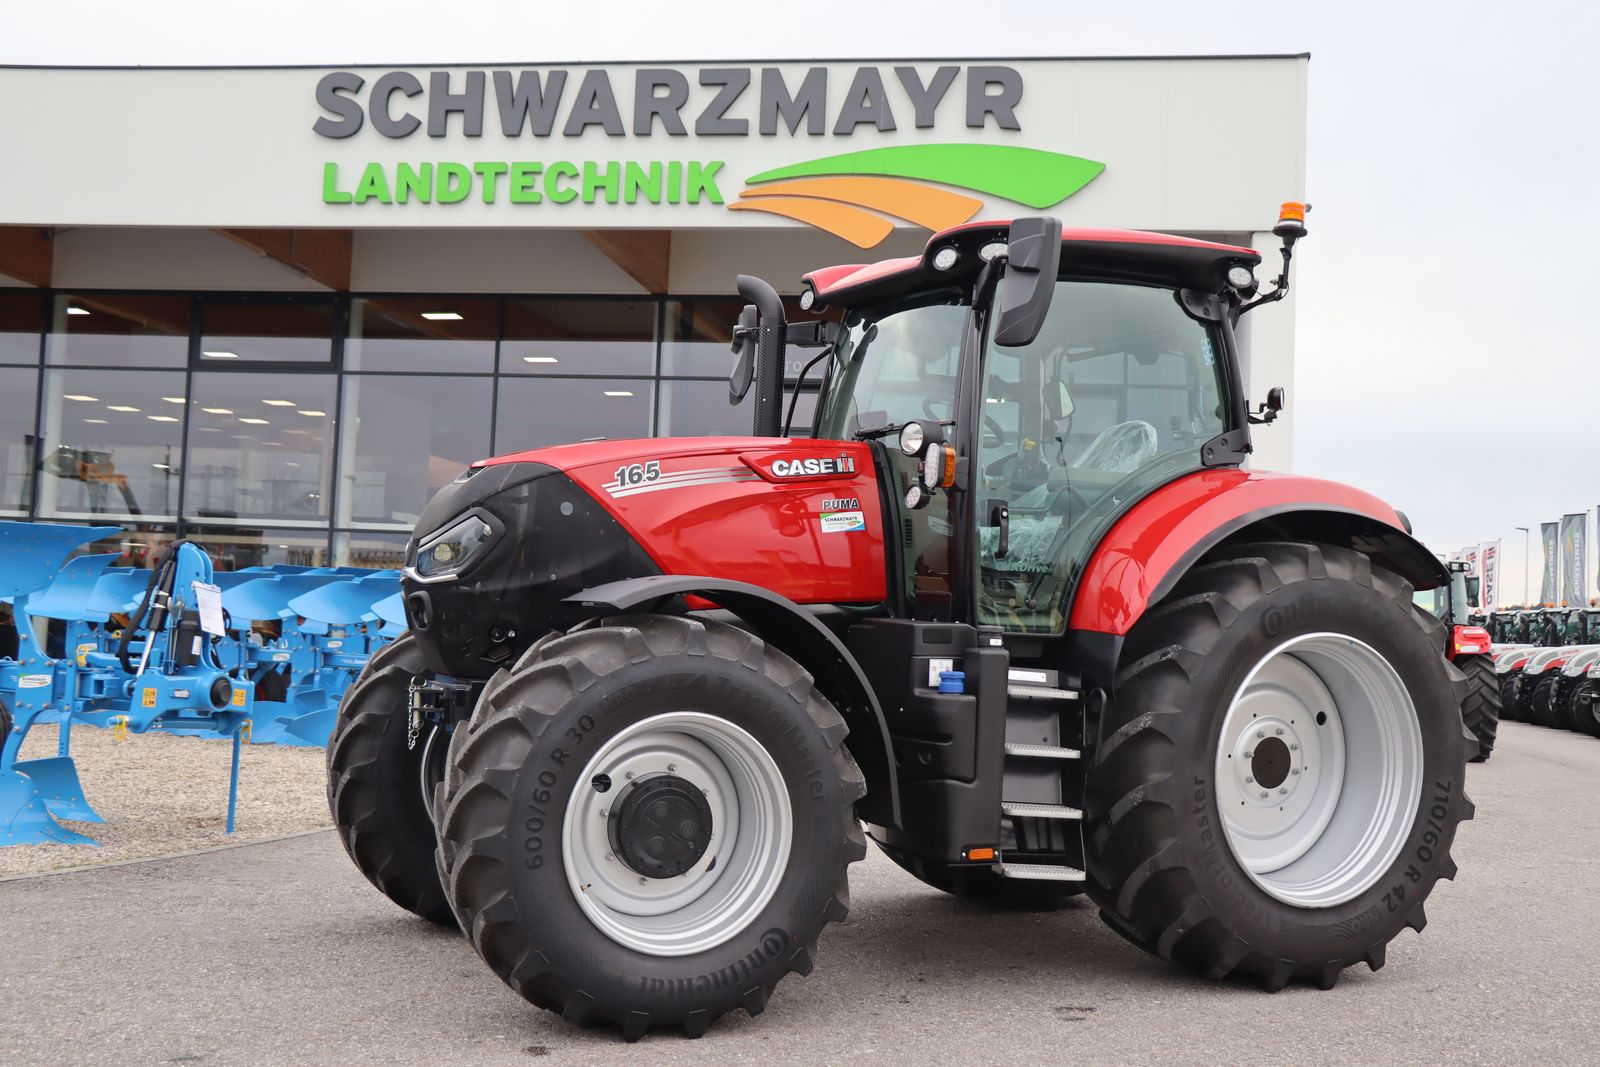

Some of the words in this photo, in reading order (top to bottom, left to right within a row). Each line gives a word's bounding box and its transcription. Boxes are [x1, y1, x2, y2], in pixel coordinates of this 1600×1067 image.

[312, 65, 1024, 139] SCHWARZMAYR
[322, 160, 725, 205] LANDTECHNIK
[614, 461, 661, 488] 165
[771, 457, 833, 477] CASE
[822, 498, 859, 511] PUMA
[525, 770, 557, 870] 600/60
[549, 745, 572, 766] R
[565, 713, 596, 743] 30
[1415, 780, 1452, 863] 710/60
[1404, 864, 1422, 884] R
[1382, 884, 1406, 913] 42
[639, 927, 790, 998] Continental
